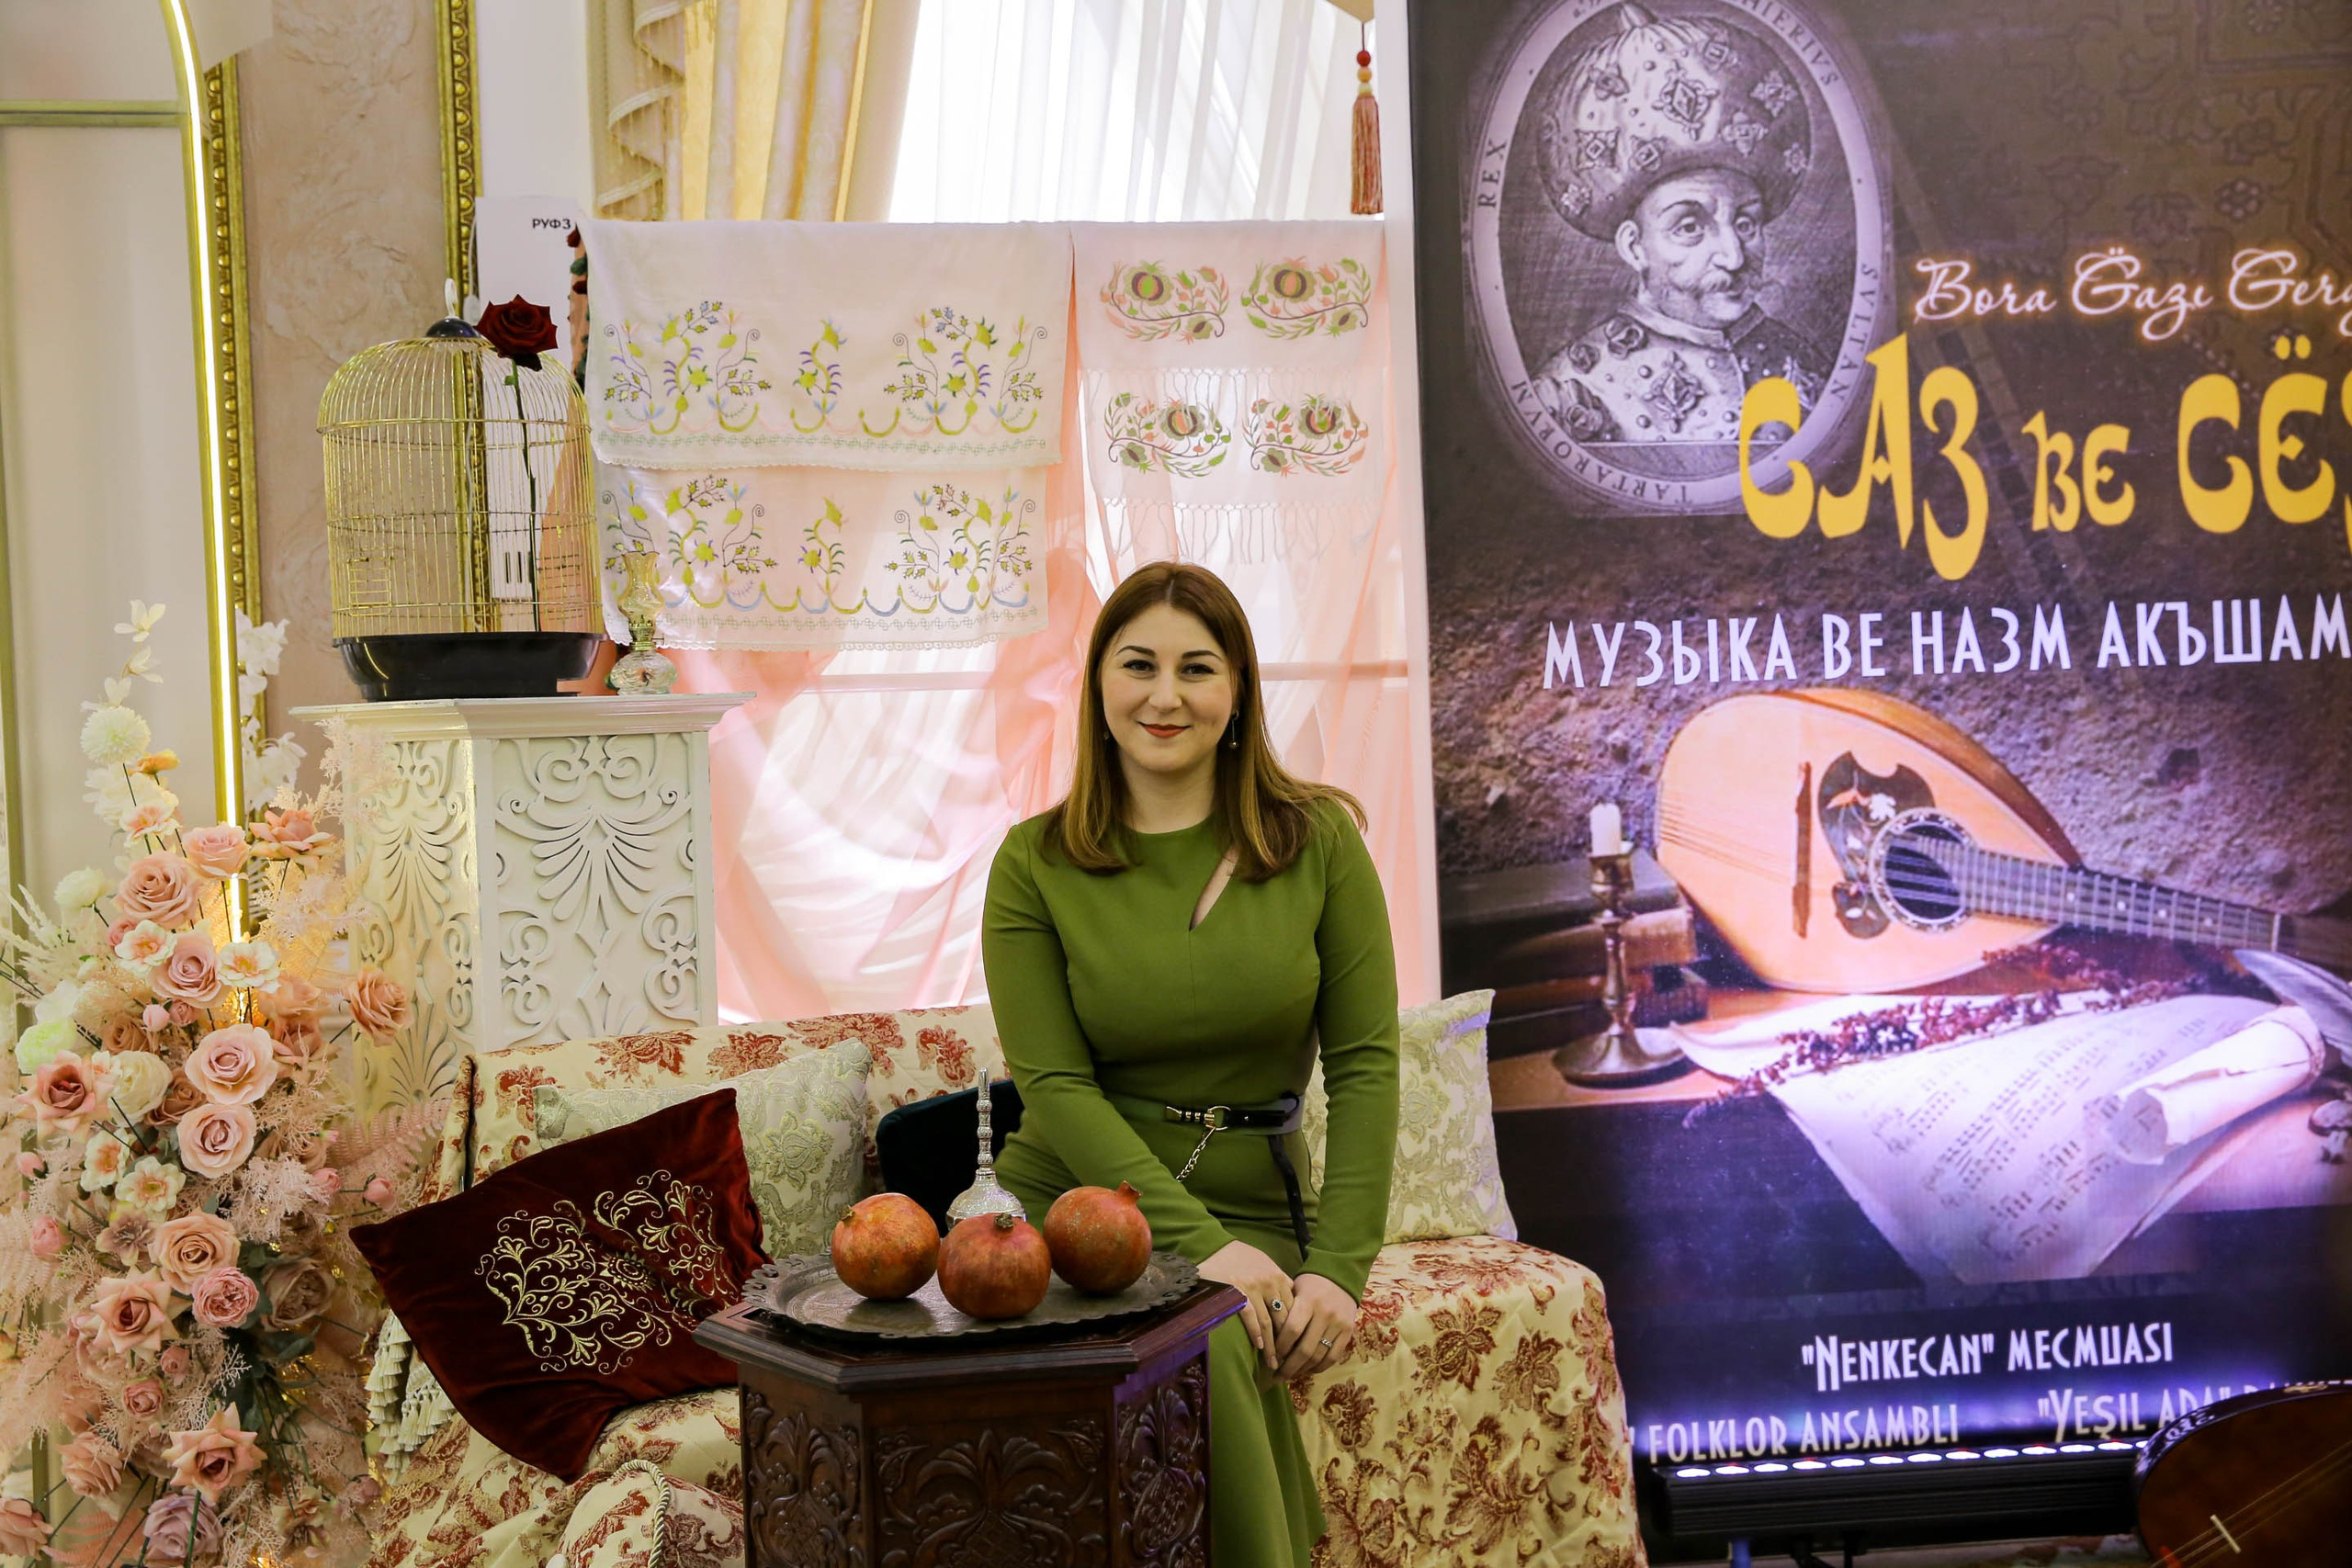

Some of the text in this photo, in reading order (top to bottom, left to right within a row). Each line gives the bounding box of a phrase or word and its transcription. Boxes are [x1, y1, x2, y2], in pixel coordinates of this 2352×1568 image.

[1476, 139, 1507, 209] REX
[1830, 263, 1879, 401] SVLTAN
[1914, 258, 2057, 324] Bora
[1738, 332, 1989, 581] САЗ
[2177, 333, 2352, 554] СЁ
[1543, 592, 2351, 690] МУЗЫКА ВЕ НАЗМ АКЪШАМ
[1648, 1416, 1788, 1464] FOLKLOR
[1799, 1403, 1960, 1454] ANSAMBLI
